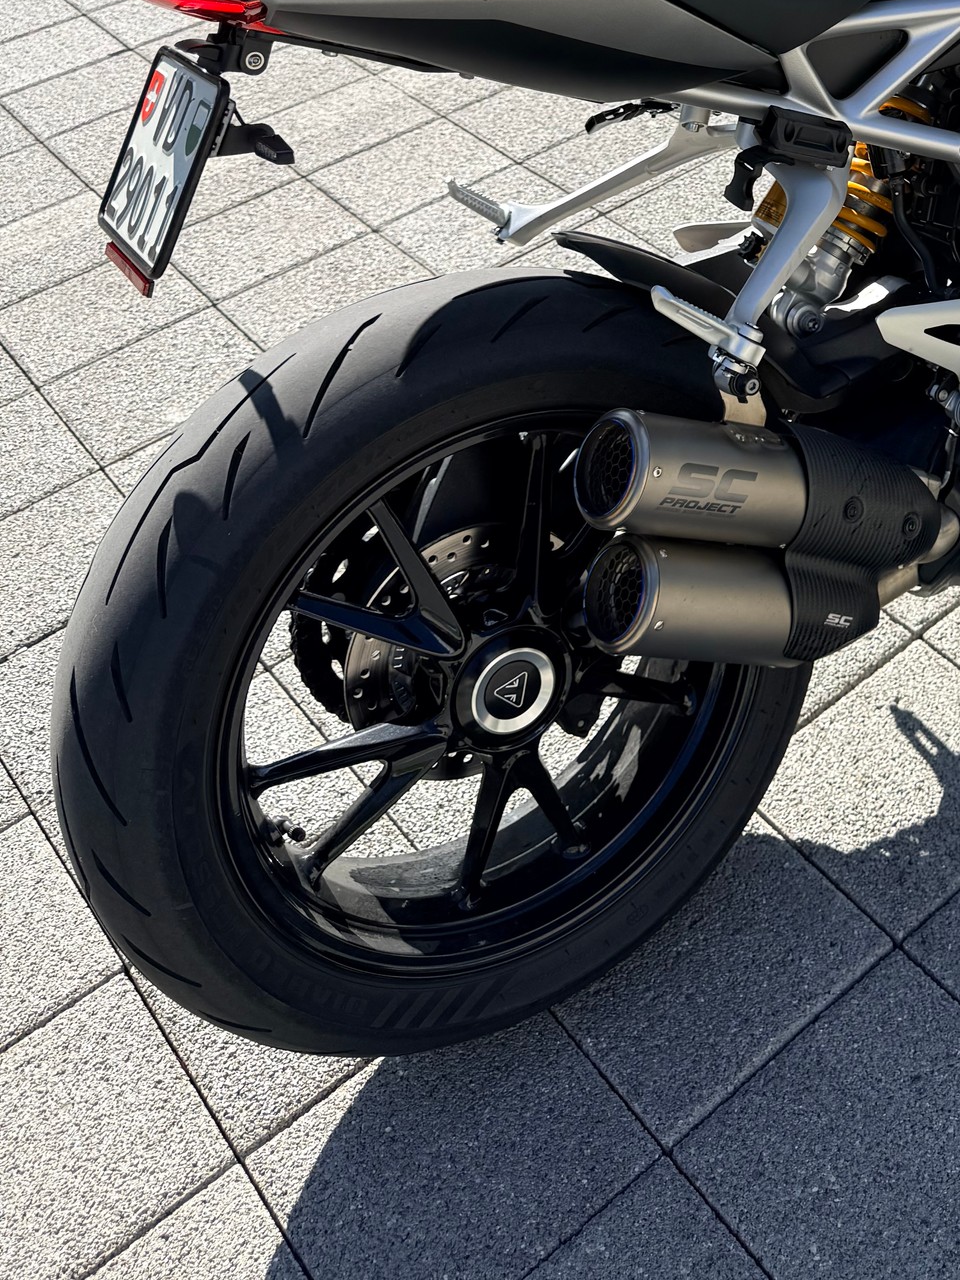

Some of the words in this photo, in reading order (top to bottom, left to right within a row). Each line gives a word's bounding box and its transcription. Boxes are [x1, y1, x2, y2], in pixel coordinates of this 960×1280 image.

[152, 68, 194, 154] VD
[106, 146, 179, 263] 29011
[668, 462, 758, 504] SC
[659, 497, 742, 514] PROJECT
[826, 613, 853, 625] SC
